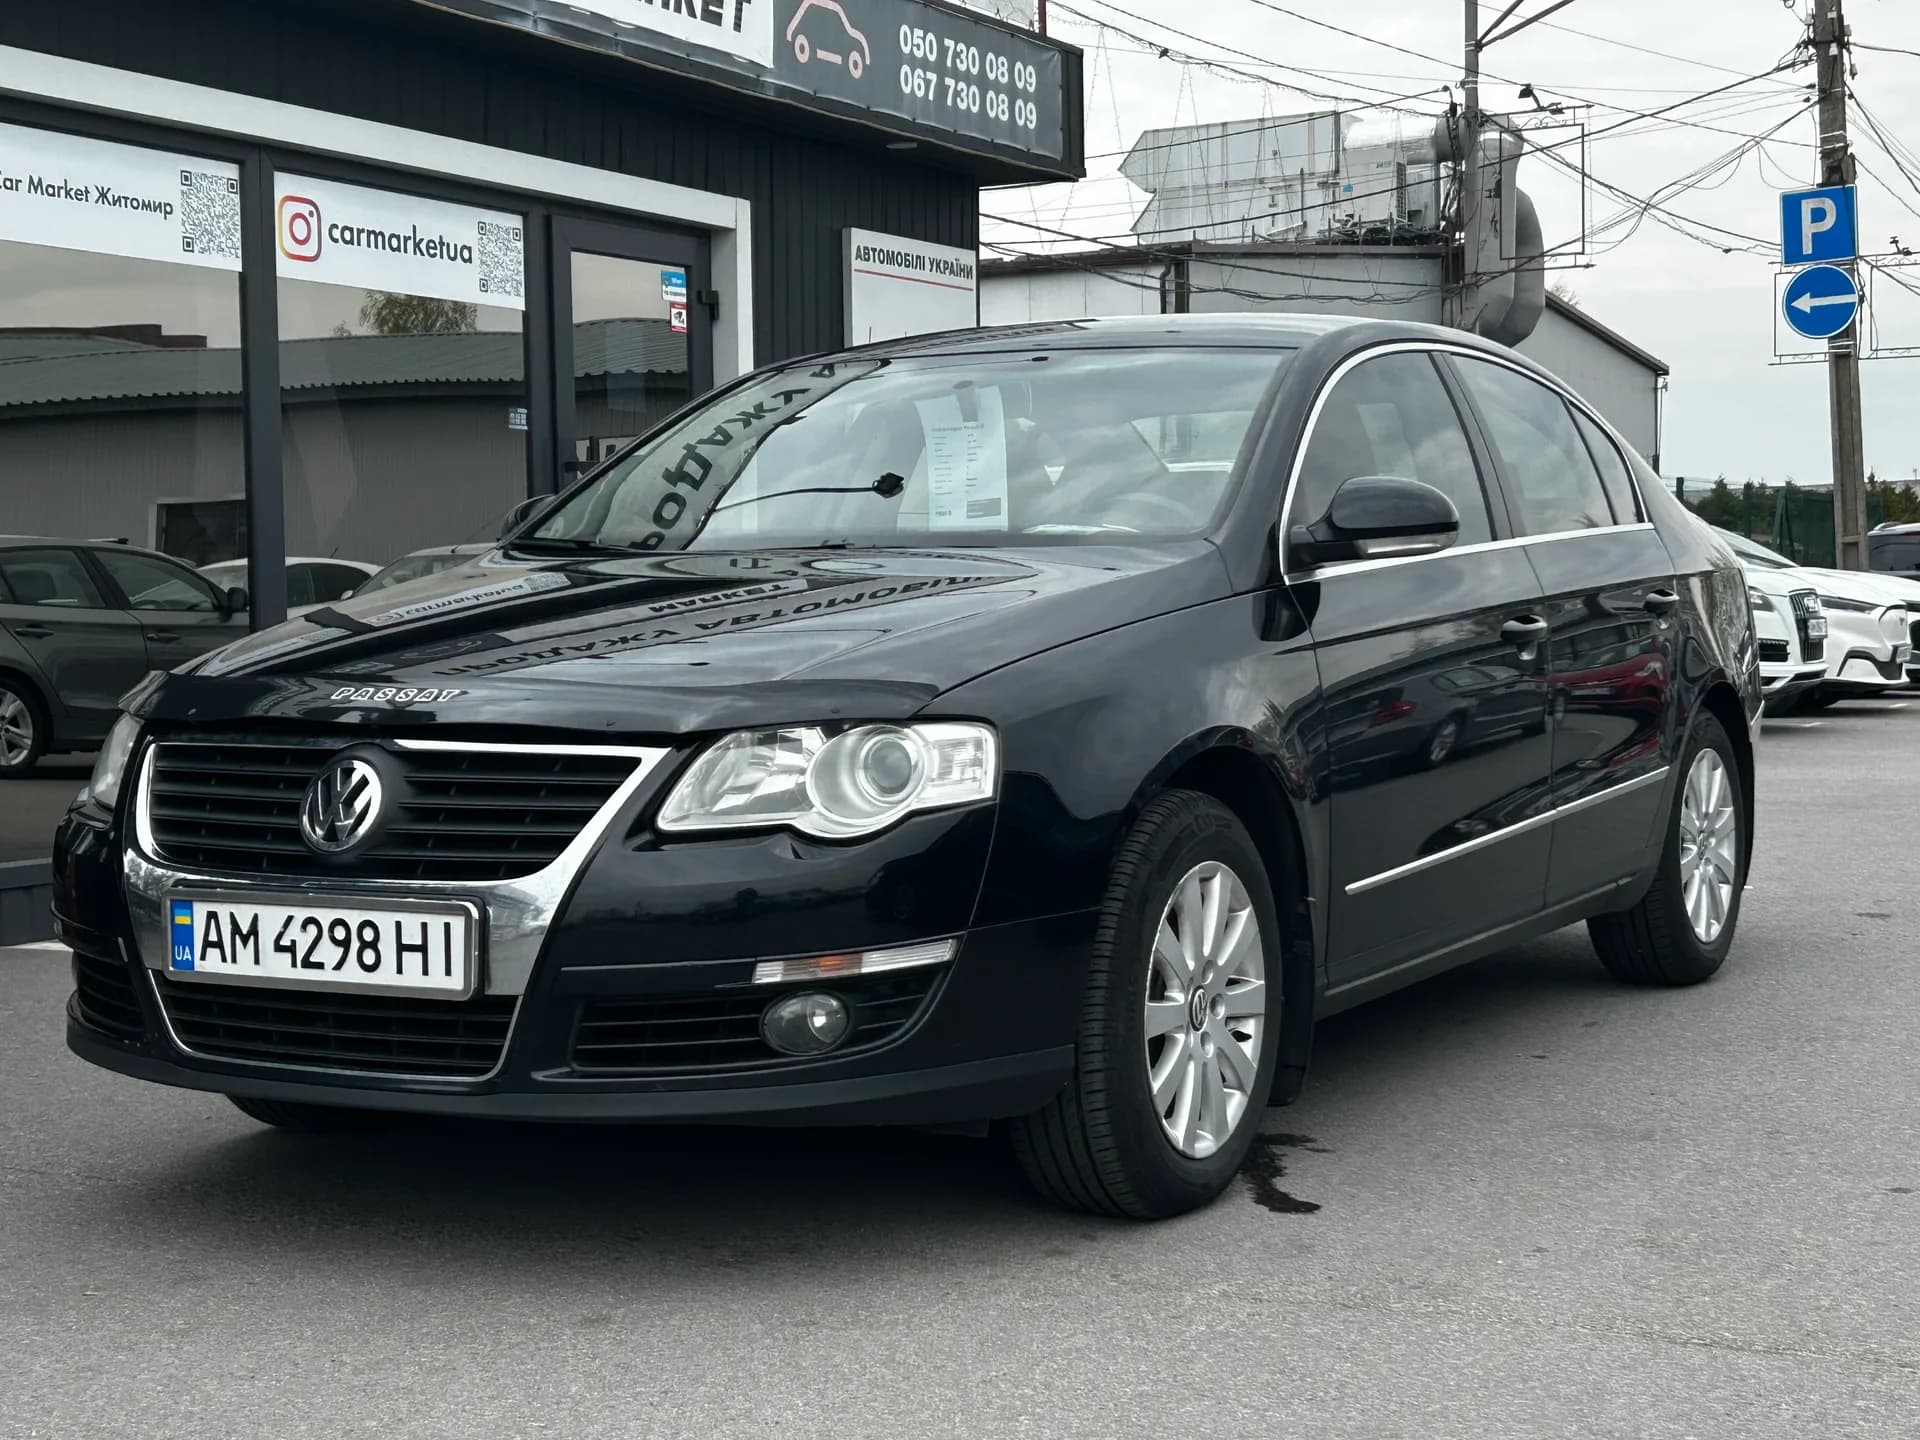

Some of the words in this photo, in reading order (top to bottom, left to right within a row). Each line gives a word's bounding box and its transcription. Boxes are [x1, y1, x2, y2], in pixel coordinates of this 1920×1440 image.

[899, 24, 938, 62] 050
[944, 37, 980, 76] 730
[985, 51, 1009, 84] 08
[1014, 61, 1037, 93] 09
[900, 64, 938, 101] 067
[944, 77, 980, 113] 730
[986, 90, 1009, 121] 08
[1014, 98, 1037, 130] 09
[0, 169, 22, 192] ar
[27, 174, 90, 203] Market
[94, 184, 174, 221] Житомир
[327, 221, 473, 265] carmarketua
[1801, 197, 1837, 255] P
[855, 244, 926, 272] АВТОМОБІЛІ
[928, 256, 973, 280] УКРАЇНИ
[330, 687, 461, 702] PASSAT
[174, 944, 192, 961] UA
[199, 910, 261, 966] AM
[273, 914, 382, 974] 4298
[395, 920, 452, 977] HI
